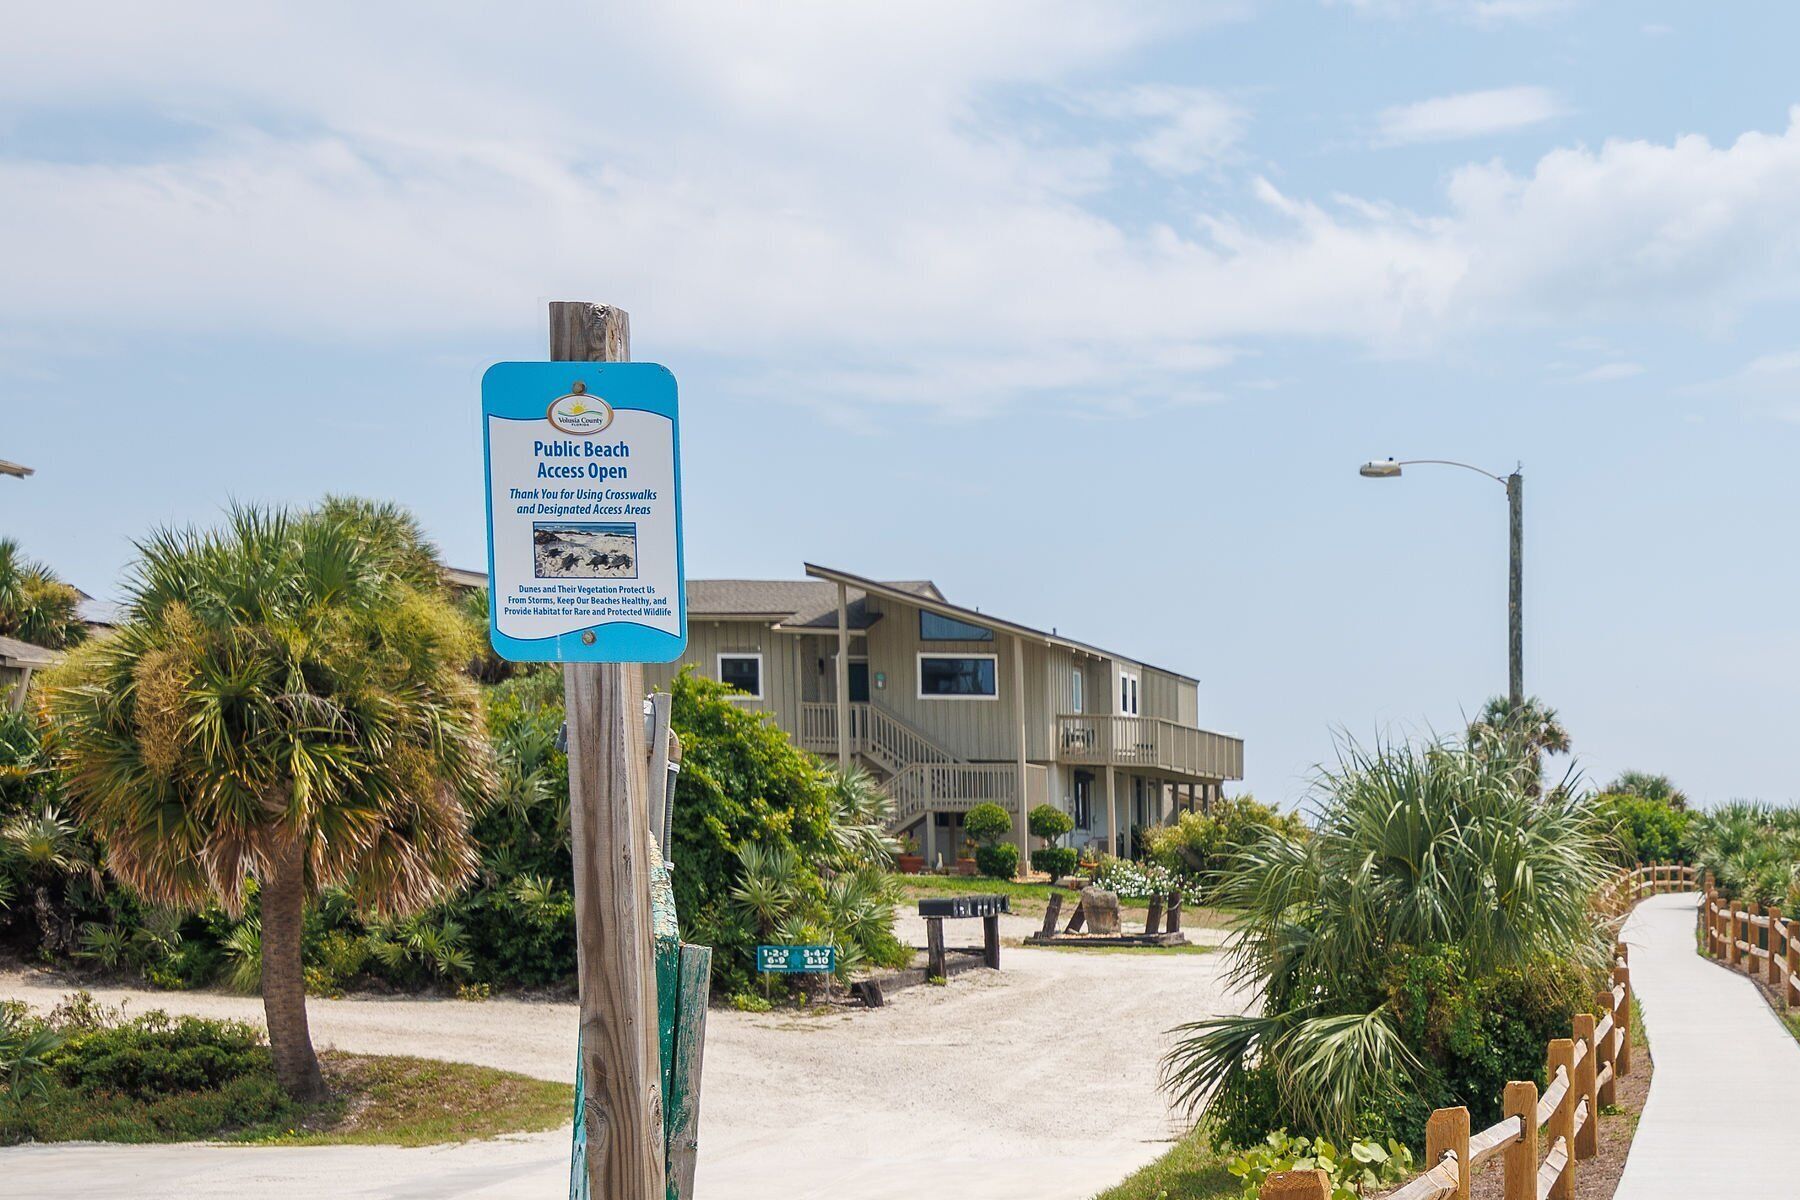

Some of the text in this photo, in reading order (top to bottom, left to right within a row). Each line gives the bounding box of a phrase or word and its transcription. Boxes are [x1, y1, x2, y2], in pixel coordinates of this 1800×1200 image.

[558, 416, 604, 426] Volusia County
[534, 440, 630, 458] Public Beach
[537, 462, 628, 482] Access Open
[510, 488, 657, 503] Thank You for Using Crosswalks
[516, 503, 651, 518] and Designated Access Areas
[519, 584, 656, 596] Dunes and Their Vegetation Protect Us
[508, 596, 667, 607] From Storms, Keep Our Beaches Healthy, and
[504, 607, 672, 617] Provide Habitat for Rare and Protected Wildlife
